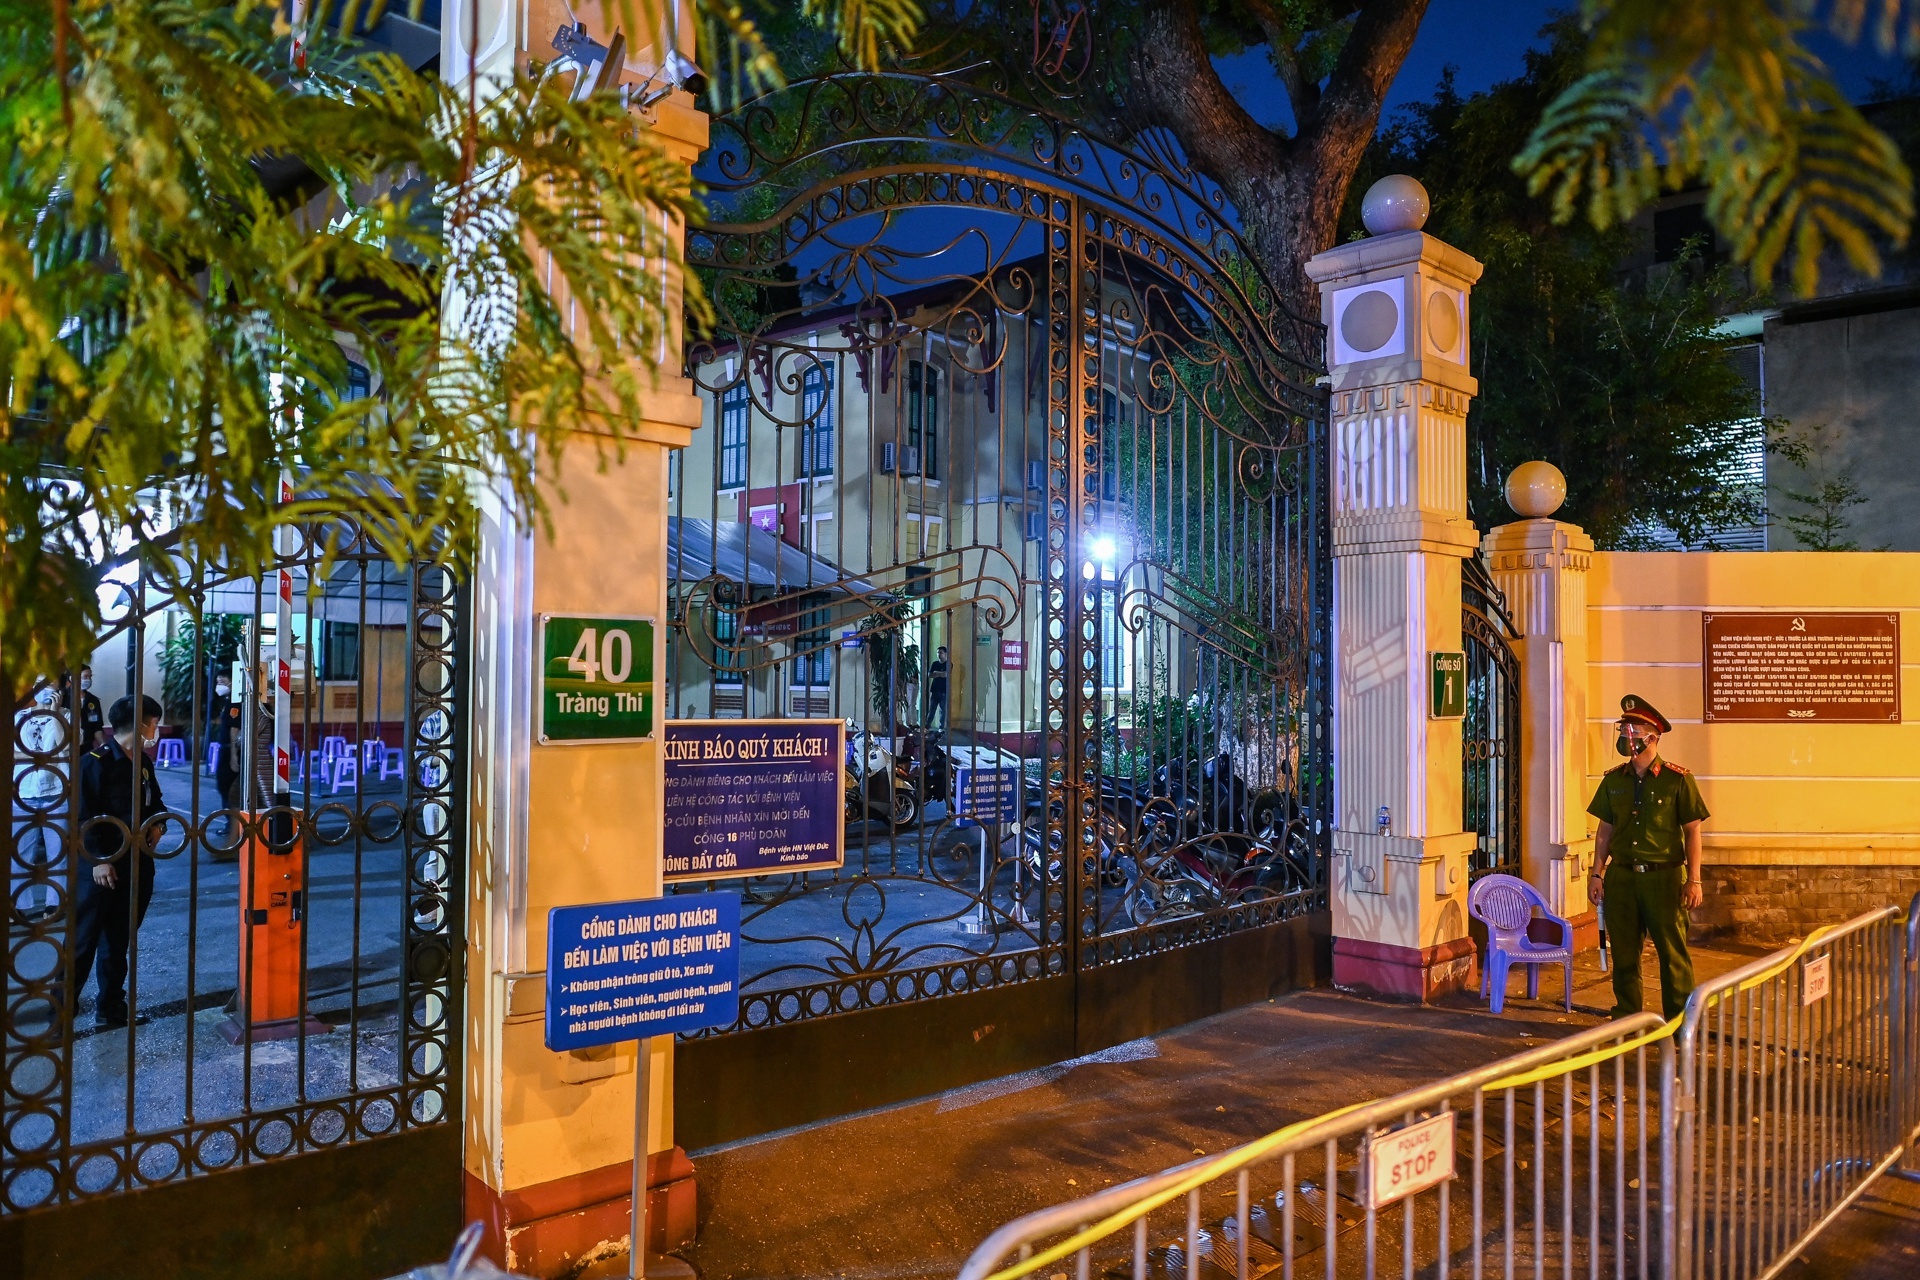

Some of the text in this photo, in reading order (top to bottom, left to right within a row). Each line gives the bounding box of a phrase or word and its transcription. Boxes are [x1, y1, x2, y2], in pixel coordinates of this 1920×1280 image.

[568, 628, 632, 683] 40
[1446, 676, 1452, 704] 1
[556, 692, 642, 717] Tràng Thi
[704, 734, 734, 759] BÁO
[738, 733, 769, 759] QUÝ
[681, 775, 705, 786] DÀNH
[707, 774, 731, 786] RIÊNG
[733, 775, 752, 785] CHO
[753, 771, 781, 784] KHÁCH
[782, 770, 798, 783] ĐẾN
[800, 771, 815, 782] LÀM
[818, 770, 834, 783] VIỆC
[667, 794, 684, 806] LIÊN
[698, 793, 725, 805] CÔNG
[728, 792, 744, 804] TÁC
[746, 791, 760, 803] VỚI
[762, 791, 781, 804] BỆNH
[784, 790, 800, 804] VIỆN
[675, 813, 695, 826] CỨU
[698, 813, 722, 827] BỆNH
[725, 811, 751, 824] NHÂN
[772, 808, 790, 820] MỜI
[792, 805, 810, 819] ĐẾN
[694, 827, 786, 844] CỔNG 16 PHỦ DOÃN
[692, 850, 713, 869] ĐẨY
[716, 849, 737, 868] CỬA
[759, 846, 776, 855] Bệnh
[780, 854, 795, 862] Kính
[582, 907, 717, 939] CỔNG DÀNH CHO KHÁCH
[564, 930, 731, 969] ĐẾN LÀM VIỆC VỚI BỆNH VIỆN
[570, 963, 714, 993] Không nhận trông giữ Ô tô, Xe máy
[570, 981, 732, 1017] Học viên, Sinh viên, người bệnh, người
[569, 1002, 704, 1033] nhà người bệnh không đi lối này
[1398, 1131, 1430, 1150] POLICE
[1391, 1150, 1436, 1185] STOP
